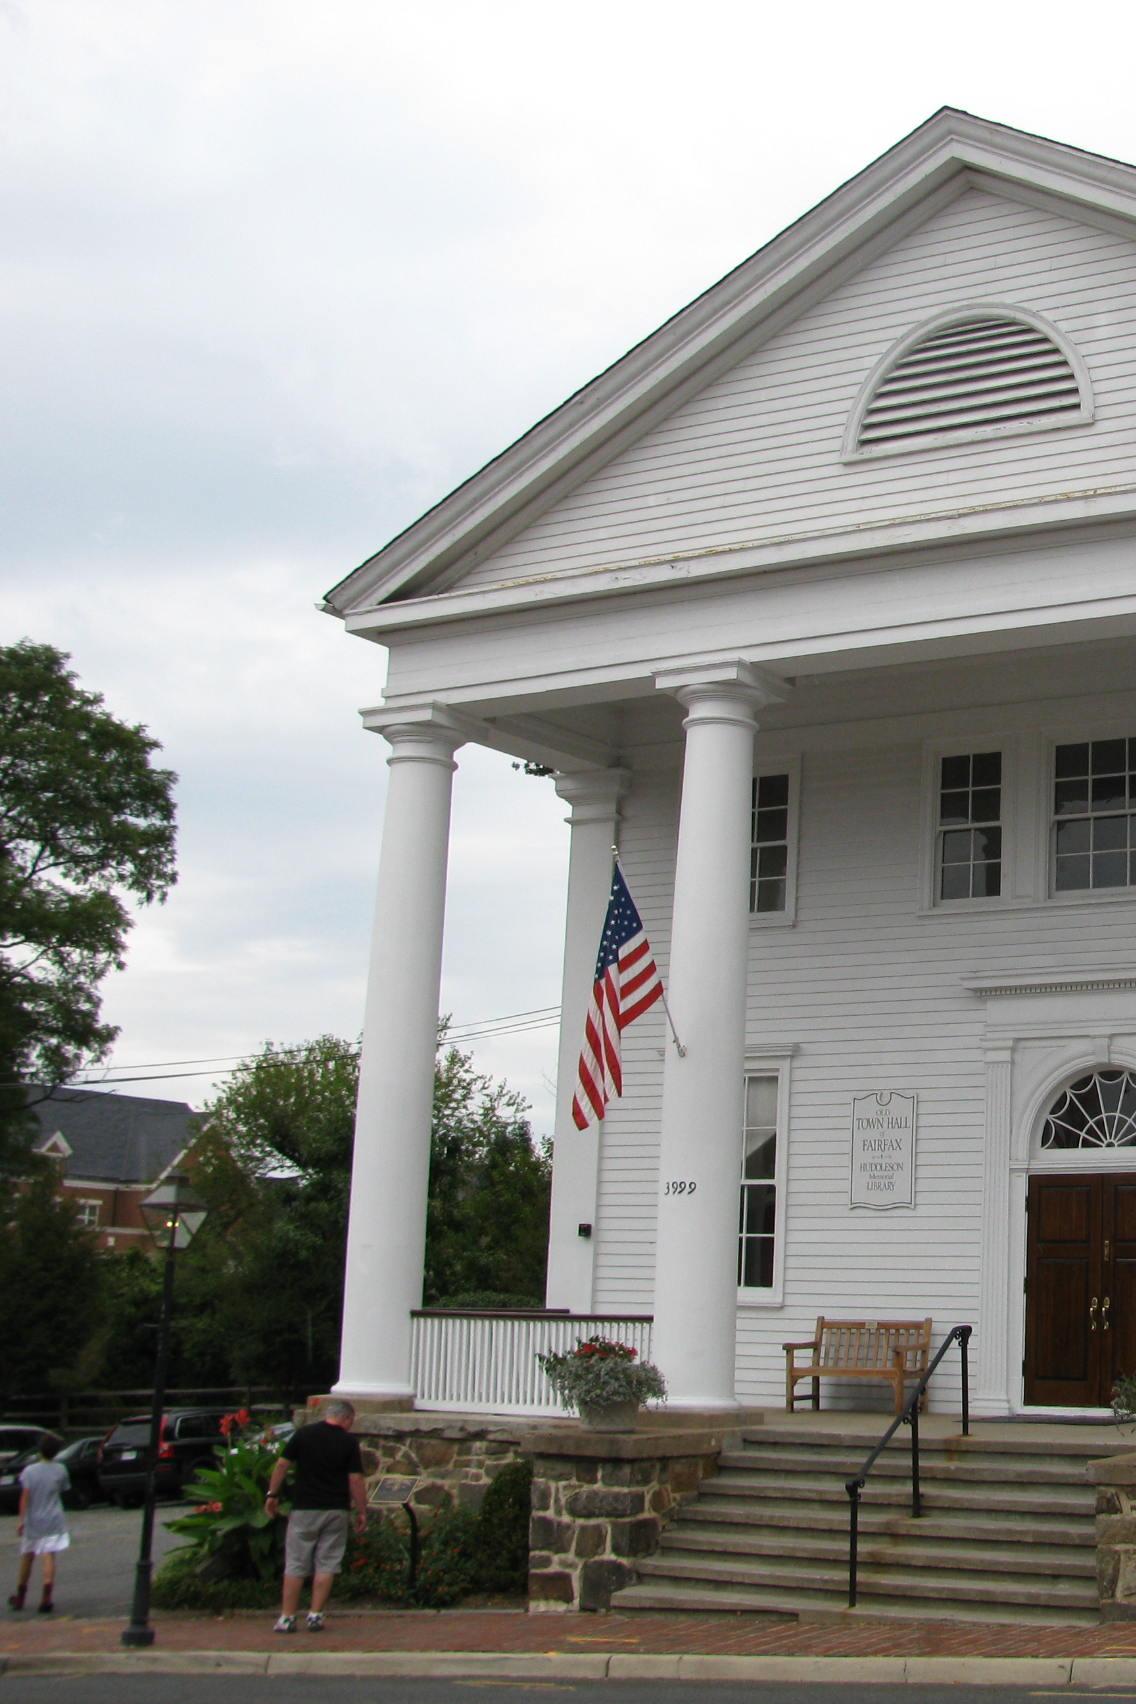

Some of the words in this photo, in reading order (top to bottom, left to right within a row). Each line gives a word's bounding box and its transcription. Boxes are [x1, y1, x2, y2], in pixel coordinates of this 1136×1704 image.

[856, 1117, 884, 1130] TOWN
[887, 1116, 911, 1129] HALL
[862, 1138, 902, 1152] FAIRFAX
[860, 1162, 904, 1173] HUDDLESON
[664, 1180, 697, 1196] 3999
[866, 1181, 896, 1192] LIBRARY
